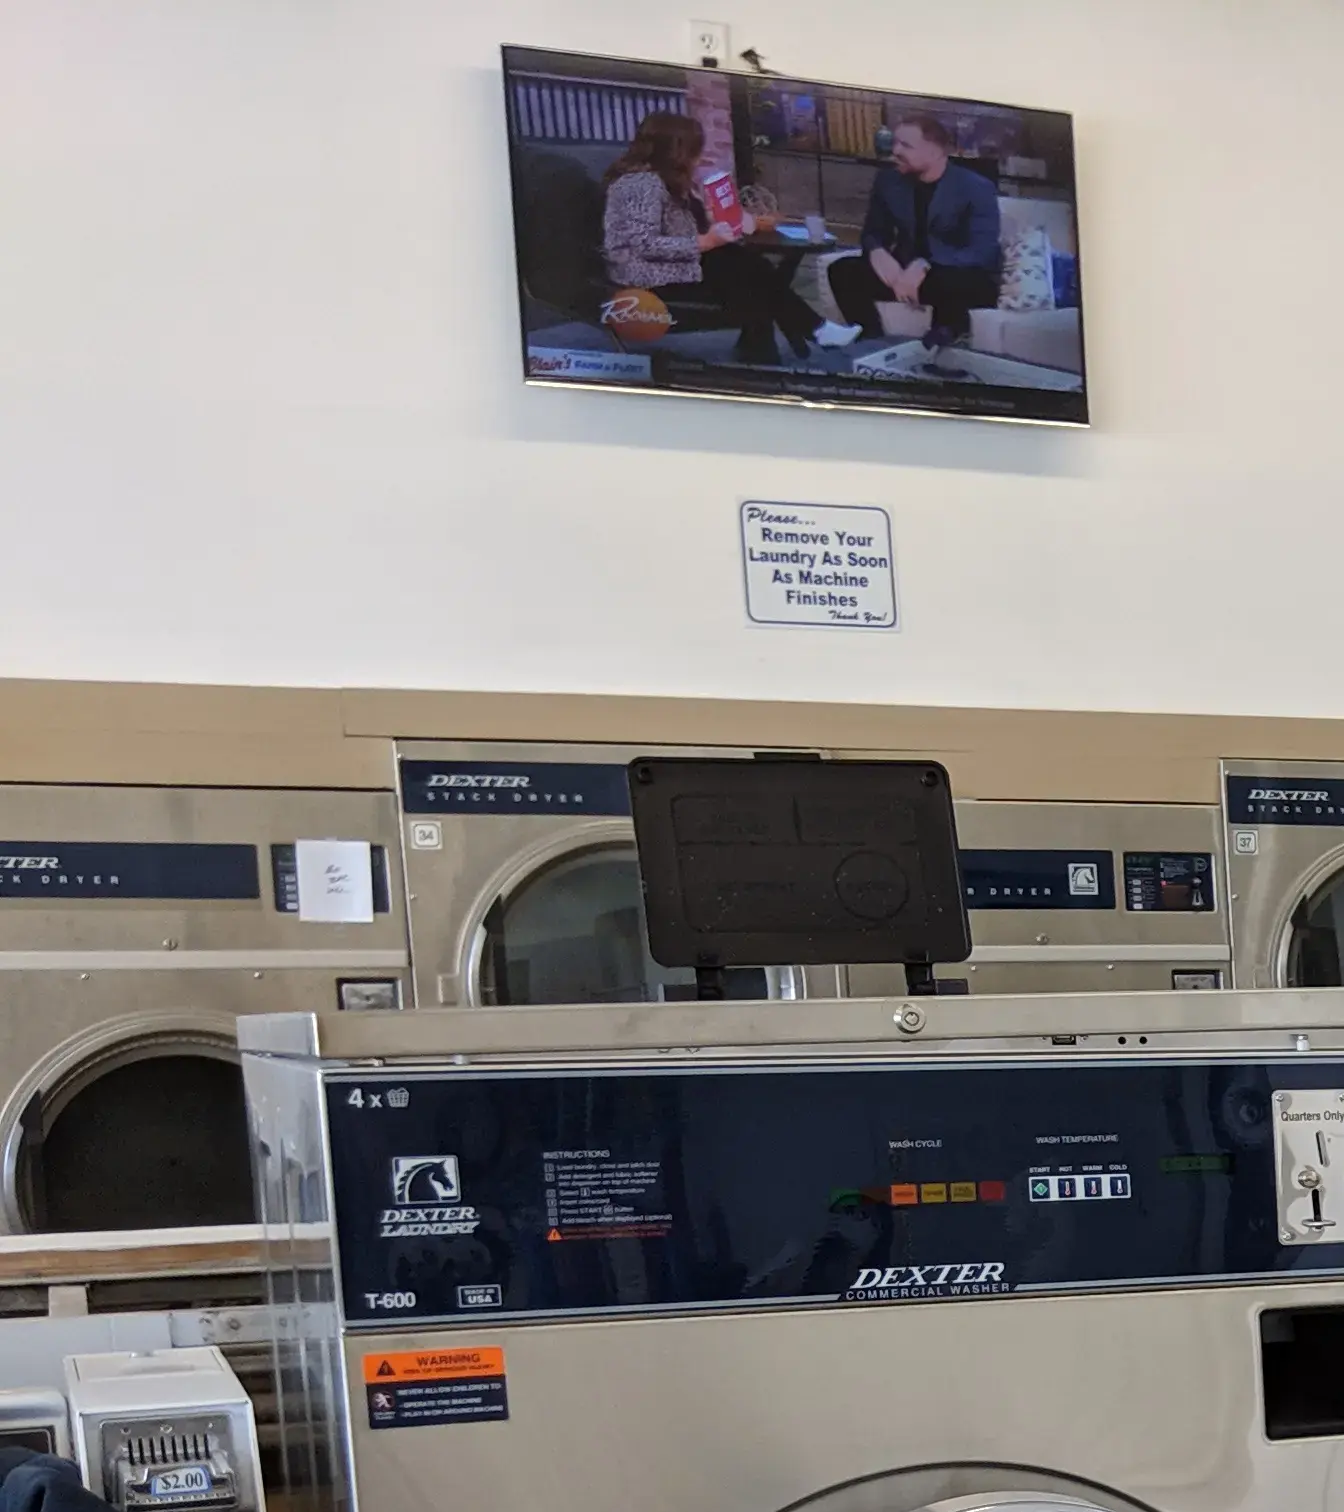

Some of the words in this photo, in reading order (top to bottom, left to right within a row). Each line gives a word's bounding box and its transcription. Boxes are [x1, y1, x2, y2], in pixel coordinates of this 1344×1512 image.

[761, 527, 830, 545] Remove
[834, 531, 874, 547] Your
[749, 548, 817, 568] Laundry
[822, 551, 842, 566] As
[847, 552, 888, 568] Soon
[772, 569, 793, 584] As
[798, 570, 869, 588] Machine
[785, 590, 858, 607] Finishes
[428, 774, 531, 788] DEXTER
[427, 792, 496, 802] STACK
[513, 793, 583, 803] DRYER
[1248, 789, 1330, 801] DEXTER
[1248, 804, 1302, 813] STACK
[418, 830, 434, 841] 34
[1239, 837, 1251, 847] 37
[0, 856, 60, 869] TER
[41, 874, 119, 885] DRYER
[990, 886, 1052, 897] DRYER
[1281, 1111, 1321, 1123] Quarters
[1323, 1110, 1344, 1123] Only
[889, 1140, 914, 1149] WASH
[915, 1139, 942, 1148] CYCLE
[1036, 1136, 1060, 1144] WASH
[1061, 1134, 1119, 1143] TEMPERATURE
[543, 1150, 610, 1159] INSTRUCTIONS
[381, 1206, 480, 1224] DEXTER
[380, 1220, 480, 1238] LAUNDRY
[850, 1262, 1005, 1290] DEXTER
[846, 1285, 947, 1301] COMMERCIAL
[951, 1282, 1010, 1296] WASHER
[365, 1292, 416, 1310] T-600
[468, 1294, 493, 1304] USA
[417, 1353, 481, 1367] WARNING
[161, 1471, 204, 1490] $2.00
